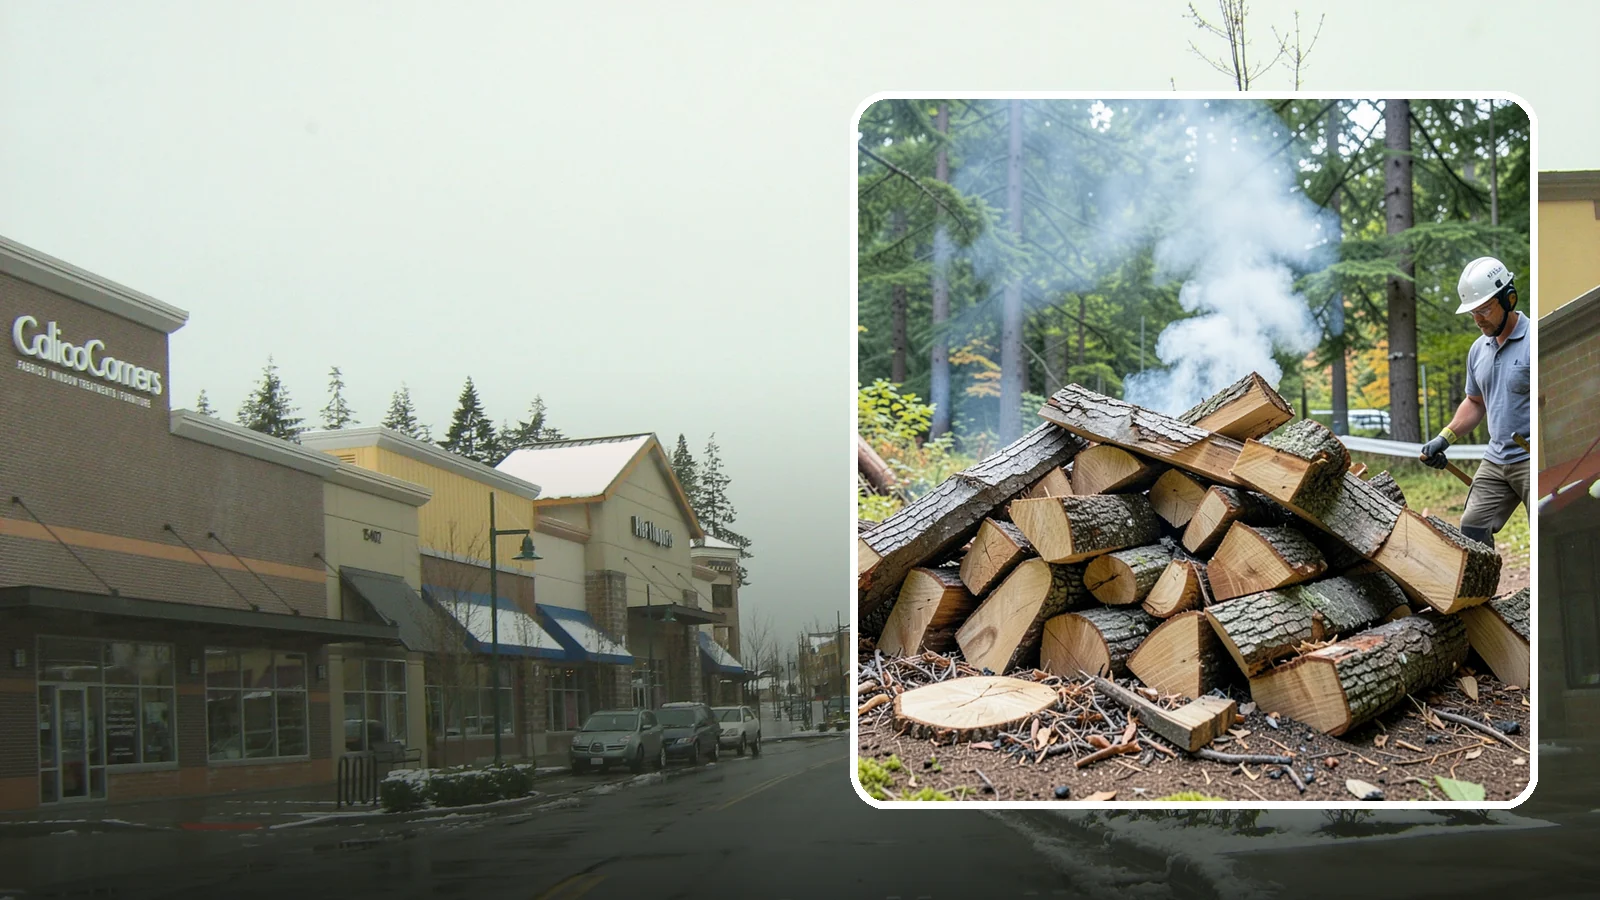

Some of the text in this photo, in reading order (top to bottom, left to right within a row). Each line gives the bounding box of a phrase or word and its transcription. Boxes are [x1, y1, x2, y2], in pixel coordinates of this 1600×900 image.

[17, 359, 151, 408] FABRICS WINDOW TREATMENTS FURNITURE
